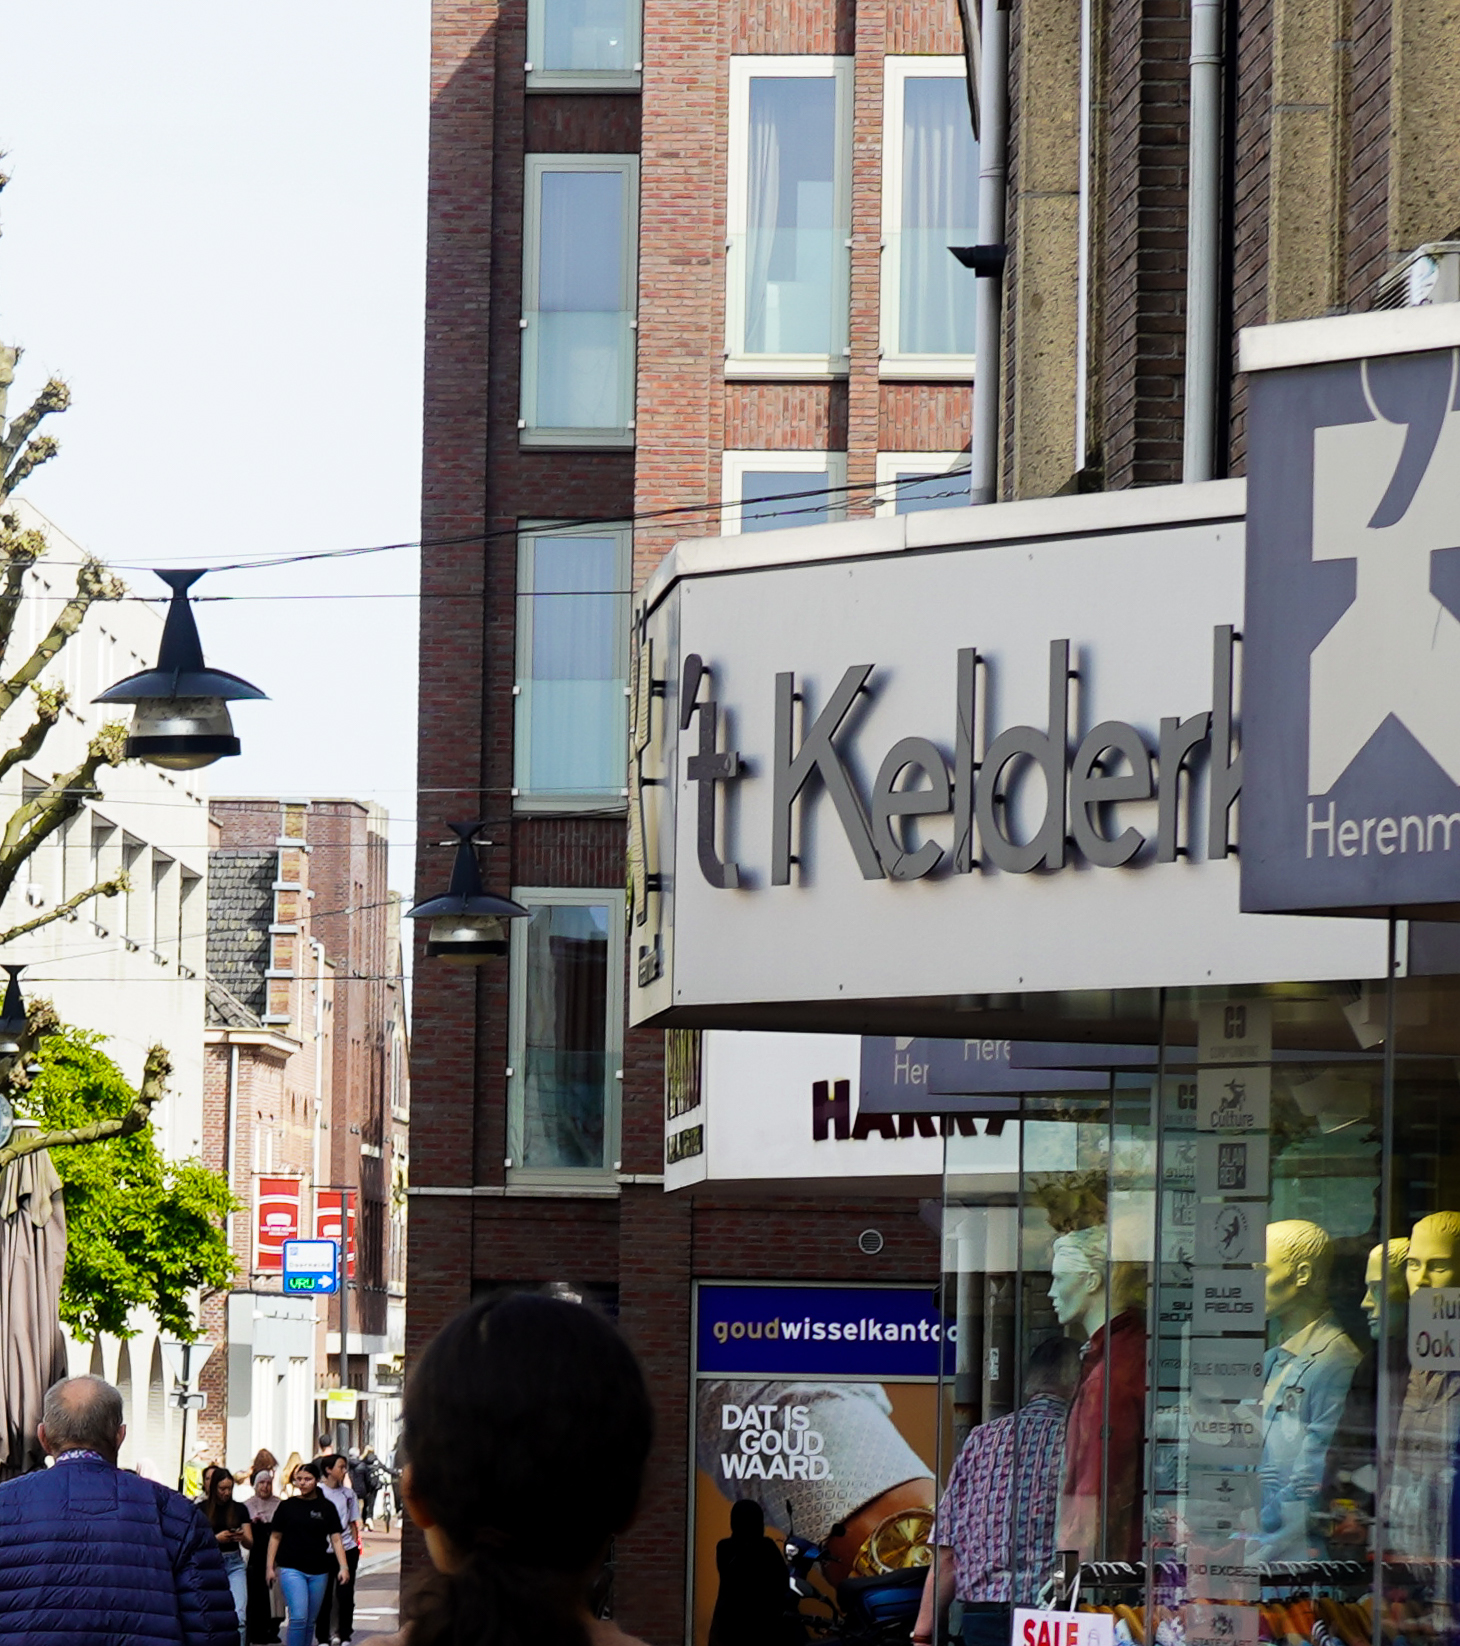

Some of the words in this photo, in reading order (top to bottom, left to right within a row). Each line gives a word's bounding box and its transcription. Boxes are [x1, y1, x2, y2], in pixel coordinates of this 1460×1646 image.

[680, 653, 740, 889] 't
[1210, 1110, 1254, 1129] Culture
[1416, 1329, 1455, 1358] Ook
[1192, 1362, 1213, 1377] BLUE
[721, 1405, 778, 1430] DAT
[784, 1405, 810, 1431] IS
[1192, 1421, 1254, 1435] ALBERTO
[740, 1430, 824, 1456] GOUD
[721, 1453, 834, 1481] WAARD.
[1210, 1564, 1259, 1578] EXCESS
